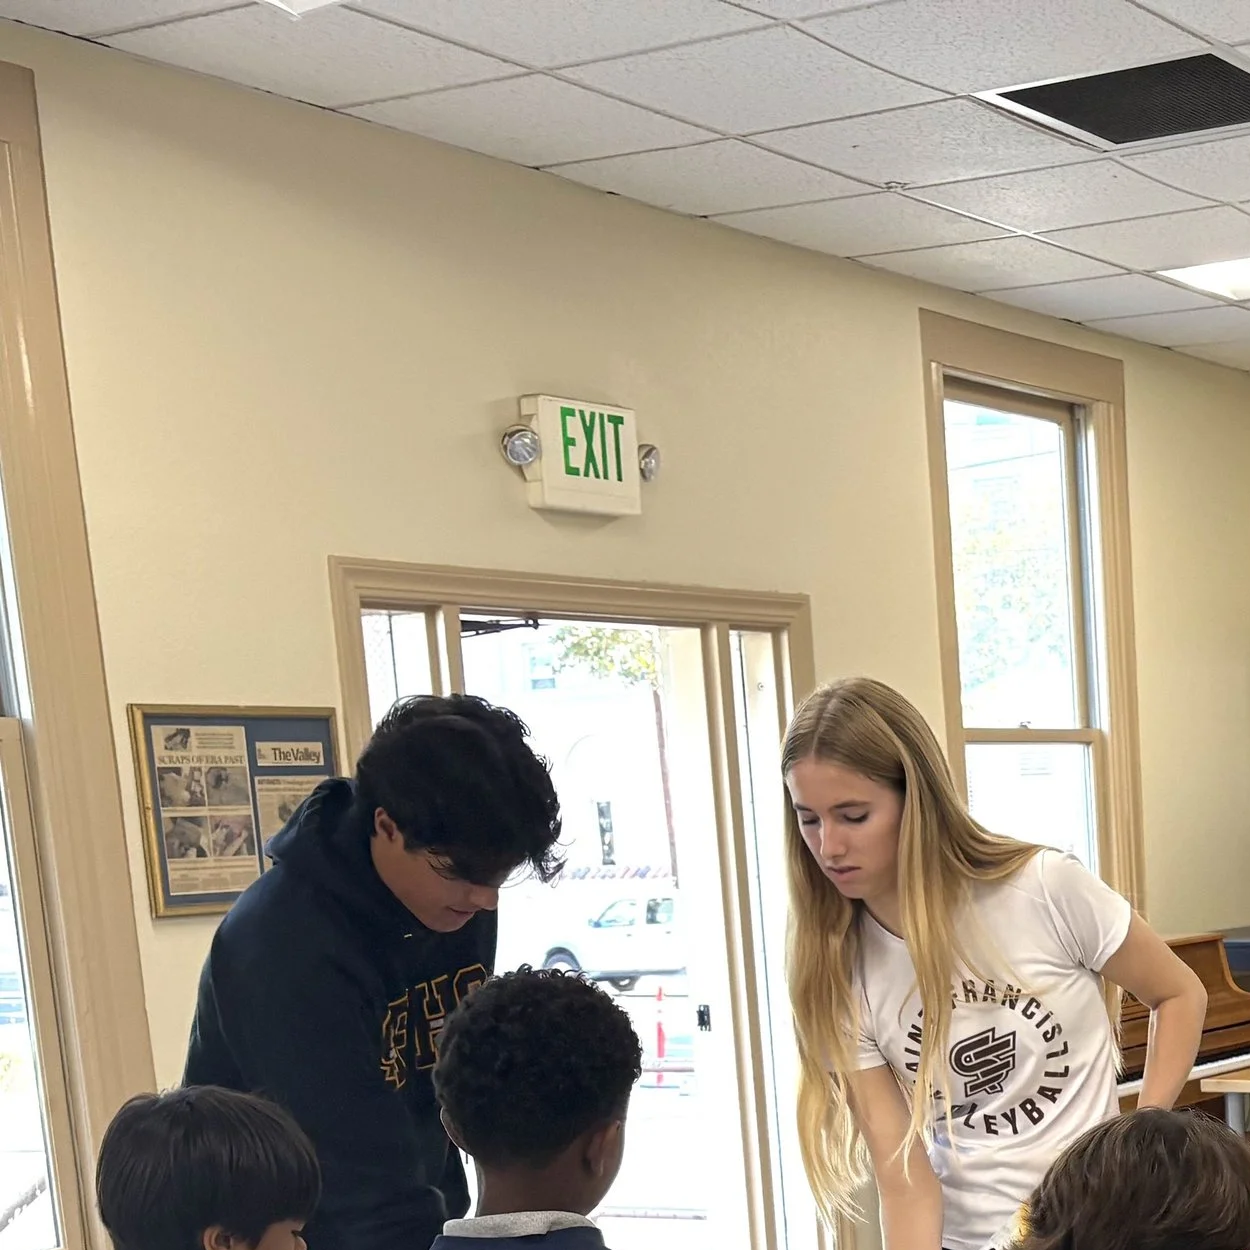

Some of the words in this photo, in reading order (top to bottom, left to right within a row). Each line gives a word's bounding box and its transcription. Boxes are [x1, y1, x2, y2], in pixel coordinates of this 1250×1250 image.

[559, 405, 625, 483] EXIT
[223, 755, 245, 764] PAST
[271, 747, 291, 762] The
[290, 747, 321, 764] Valley
